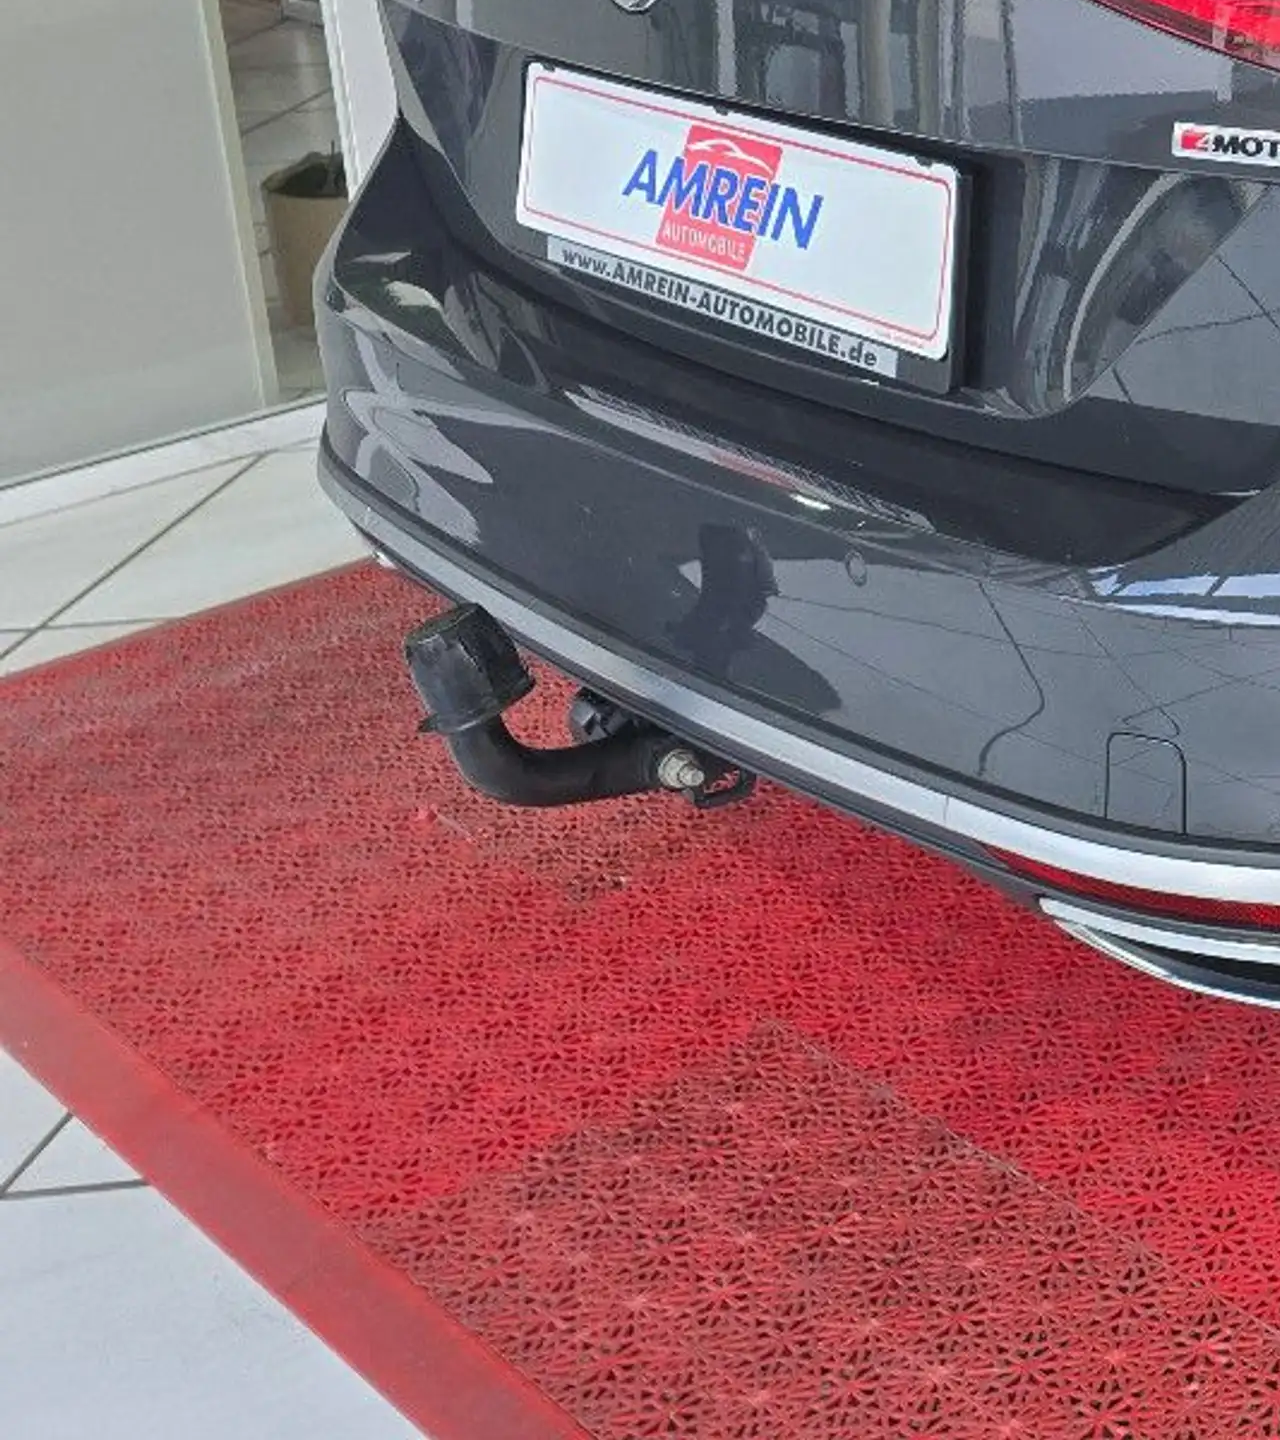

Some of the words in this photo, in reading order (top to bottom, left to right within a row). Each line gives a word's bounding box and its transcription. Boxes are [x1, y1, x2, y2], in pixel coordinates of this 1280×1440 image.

[622, 148, 824, 250] AMREIN
[662, 224, 747, 261] AUTOMOBILE
[561, 247, 878, 368] www.AMREIN-AUTOMOBILE.de
